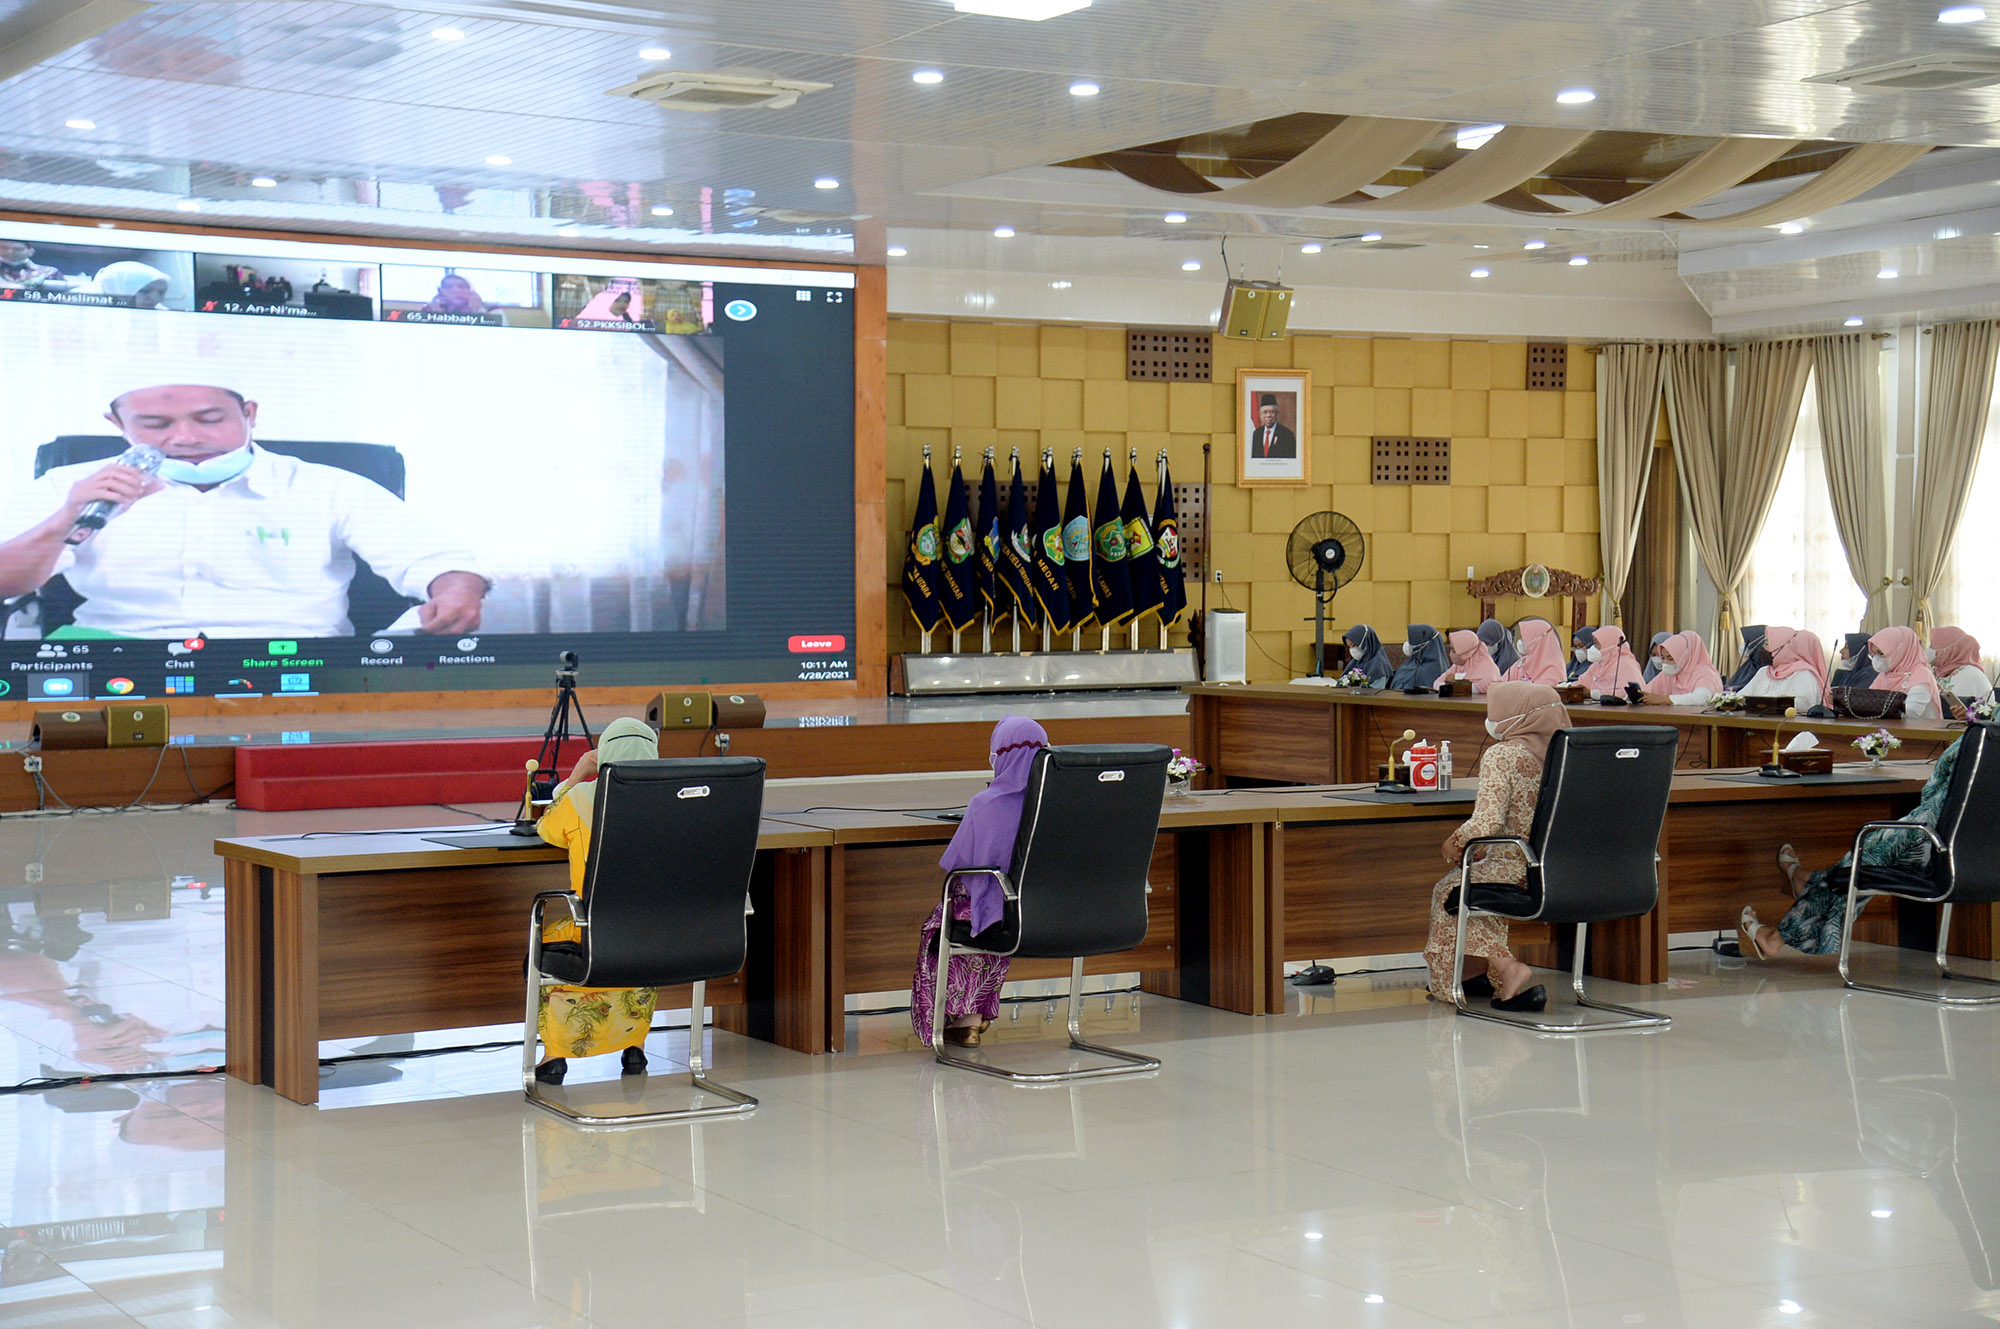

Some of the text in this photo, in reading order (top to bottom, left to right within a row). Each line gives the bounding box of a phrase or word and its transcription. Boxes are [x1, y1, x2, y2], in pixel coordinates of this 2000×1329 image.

[223, 302, 243, 313] 12.
[1037, 558, 1059, 592] MEDAN
[916, 576, 932, 599] UTARA
[72, 644, 90, 655] 65
[189, 639, 199, 649] 4
[801, 639, 833, 649] Leave
[165, 659, 195, 670] Chat
[242, 657, 324, 669] Share Screen
[360, 655, 403, 666] Record
[438, 654, 496, 665] Reactions
[801, 660, 848, 669] 10:11 AM
[11, 661, 94, 672] Participants
[798, 671, 849, 680] 4/28/2021
